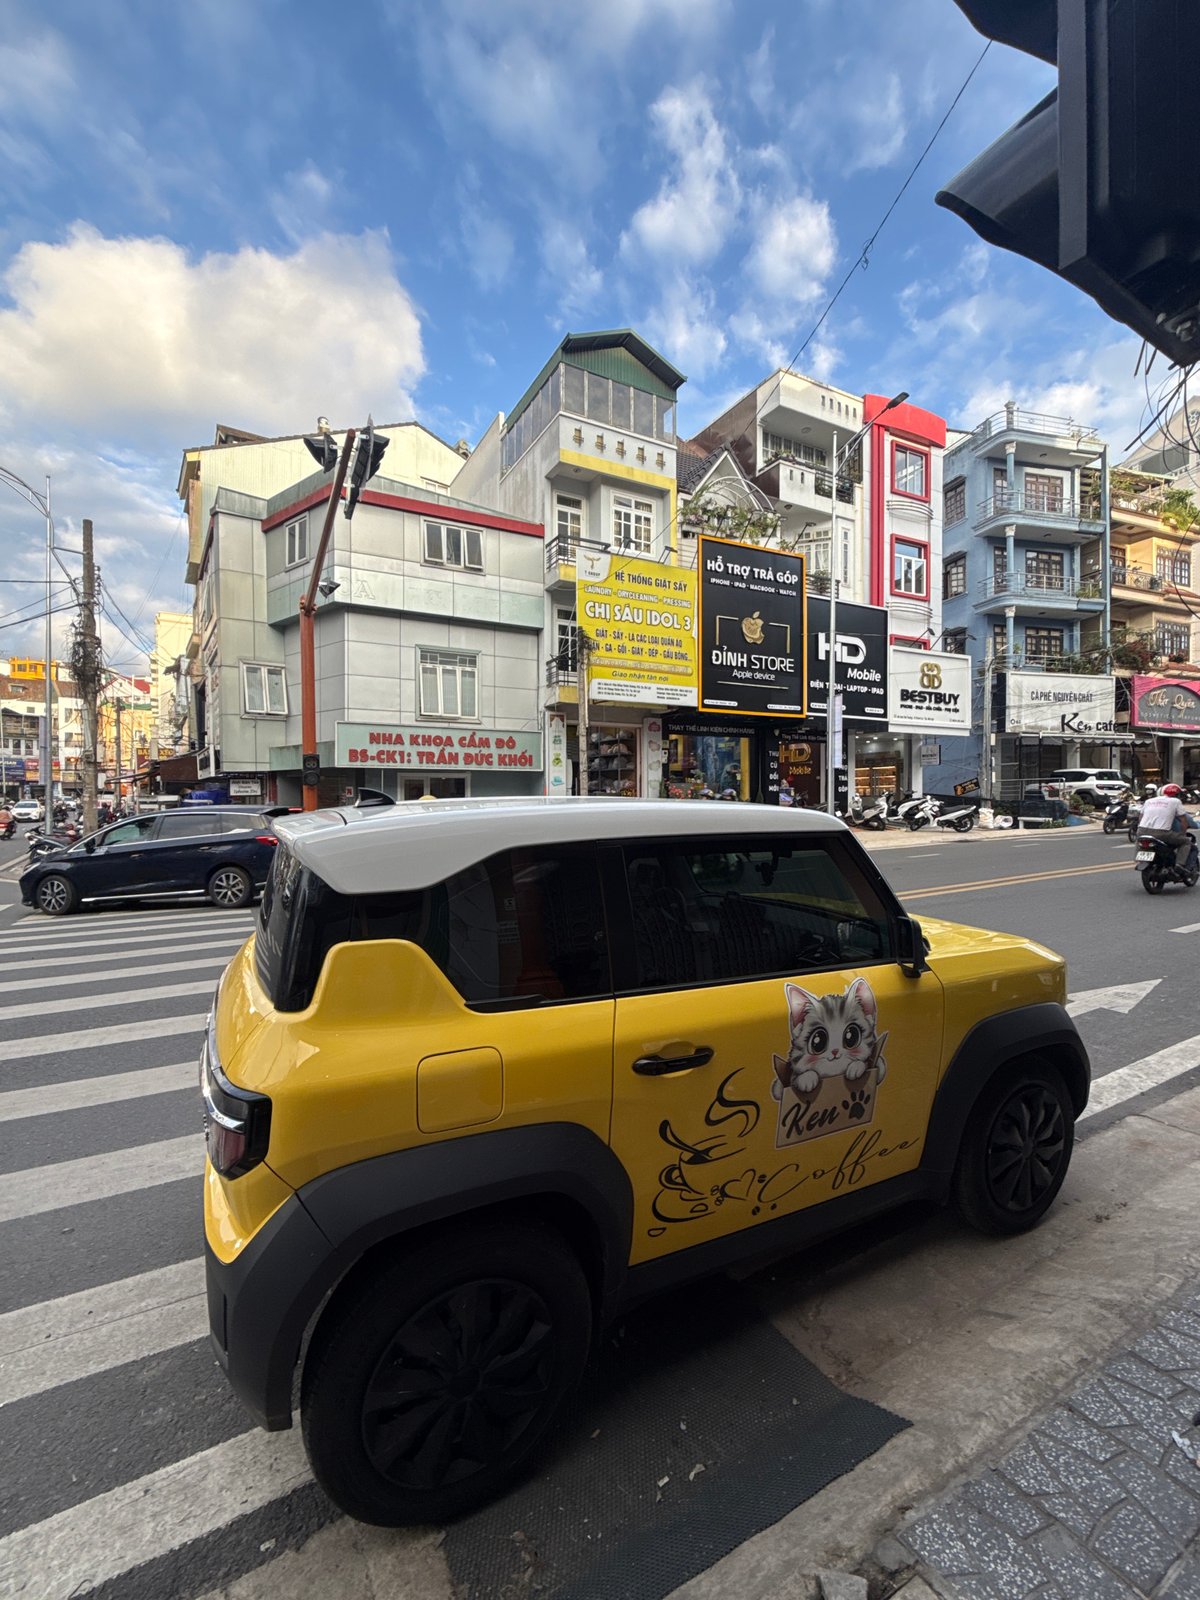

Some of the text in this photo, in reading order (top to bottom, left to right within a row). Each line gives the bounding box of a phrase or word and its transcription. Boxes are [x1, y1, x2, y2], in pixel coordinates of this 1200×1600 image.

[615, 571, 624, 584] HỆ
[628, 572, 652, 586] THỐNG
[707, 556, 798, 585] HỖ TRỢ TRẢ GÓP
[584, 584, 691, 608] LAUNDRY DRYCLEANING PRESSING
[710, 578, 730, 586] IPHONE
[750, 584, 775, 593] MACBOOK
[779, 588, 797, 596] WATCH
[585, 601, 691, 630] CHỊ SÁU IDOL 3
[712, 646, 794, 672] ĐỈNH STORE
[612, 670, 628, 678] Giao
[732, 669, 776, 680] Apple device
[847, 668, 882, 682] Mobile
[846, 684, 868, 693] LAPTOP
[900, 689, 960, 706] BESTBUY
[1061, 713, 1092, 733] Ken
[369, 732, 404, 745] NHA
[410, 734, 454, 748] KHOA
[495, 736, 516, 749] ĐÔ
[348, 747, 533, 766] BS-CK1: TRẦN ĐỨC KHỐI
[782, 1100, 839, 1139] Ken
[758, 1129, 920, 1204] Coffee
